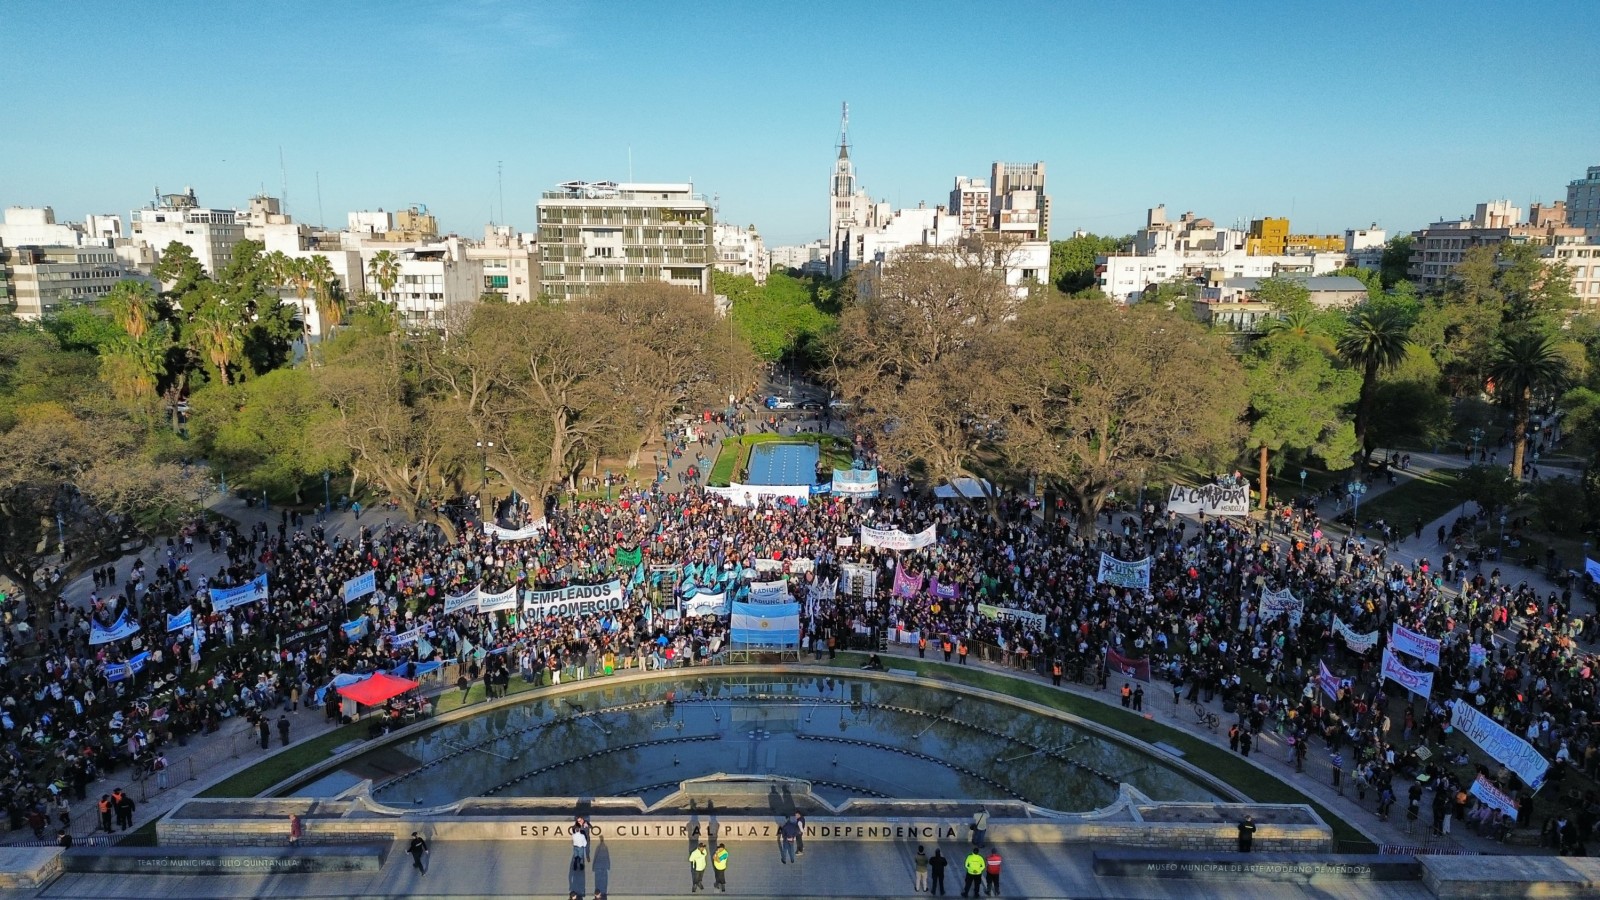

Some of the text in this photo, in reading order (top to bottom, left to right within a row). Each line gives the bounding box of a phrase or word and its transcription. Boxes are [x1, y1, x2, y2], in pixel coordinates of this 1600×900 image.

[1170, 485, 1186, 502] LA
[1221, 504, 1245, 512] MENDOZA
[1115, 565, 1135, 574] UTN
[531, 585, 612, 604] EMPLEADOS
[527, 597, 620, 619] DE COMERCIO
[996, 612, 1042, 626] CIENCIAS
[1457, 701, 1477, 722] SIN
[1456, 715, 1473, 733] NO
[1470, 725, 1489, 744] HAY
[520, 825, 602, 836] ESPAO
[616, 825, 714, 836] CULTURAL
[806, 826, 956, 837] NDEPENDENCIA
[137, 859, 298, 867] TEATRO MUNICIPAL JULIO QUINTANILLA
[1147, 863, 1178, 871] MUSEO
[1180, 864, 1228, 872] MUNICIPAL
[1265, 865, 1313, 873] MODERNO
[1327, 866, 1371, 874] MENDOZA
